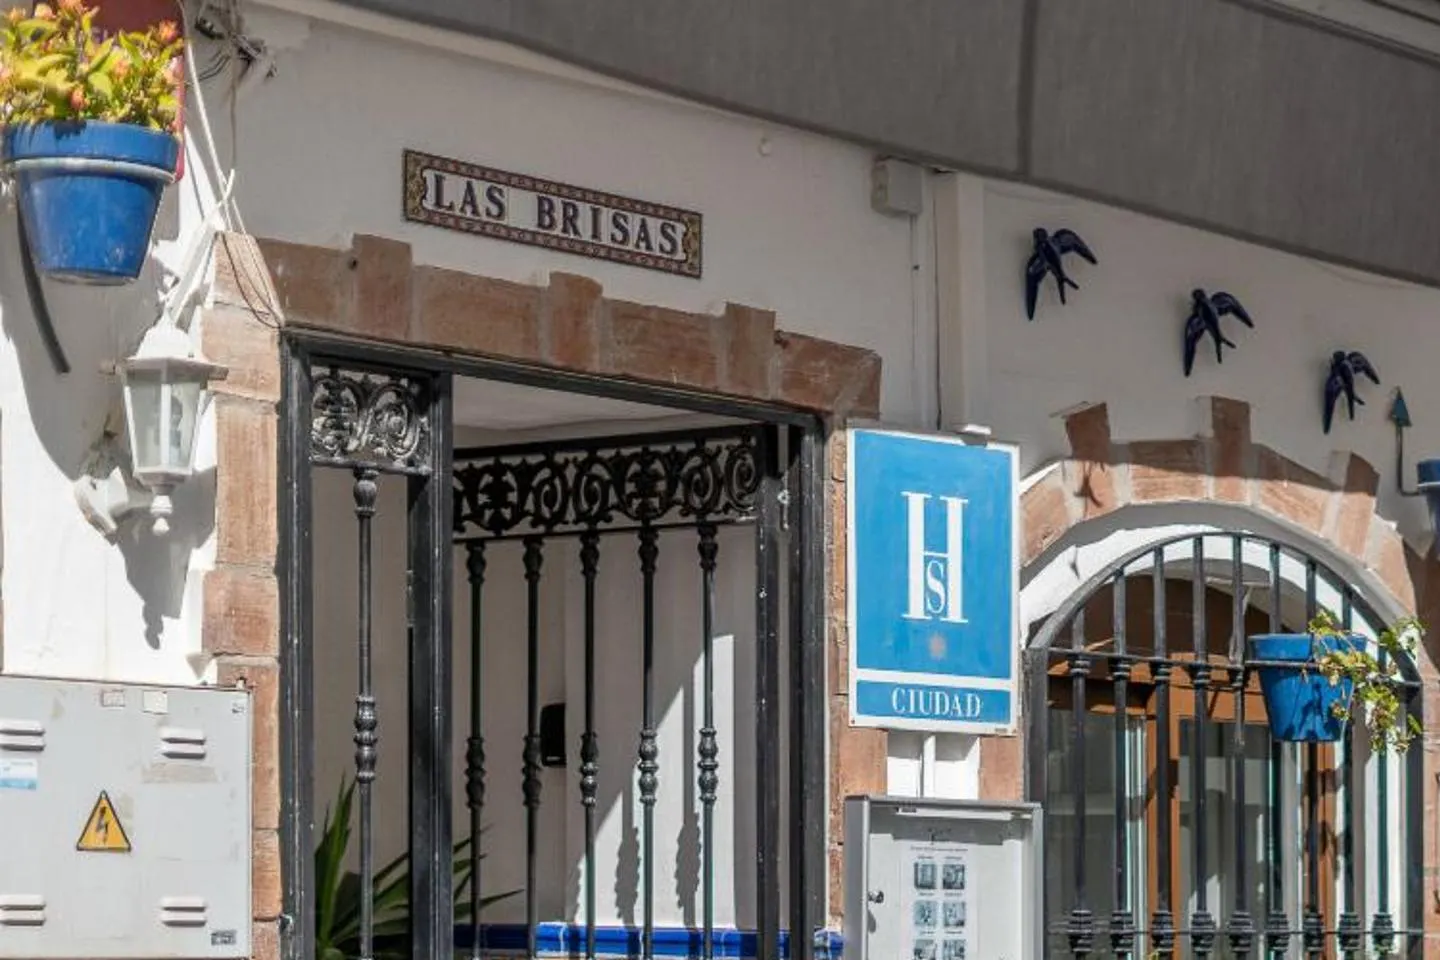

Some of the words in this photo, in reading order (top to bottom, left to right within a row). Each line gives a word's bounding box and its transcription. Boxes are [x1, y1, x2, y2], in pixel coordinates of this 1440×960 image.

[432, 174, 506, 220] LAS
[536, 195, 677, 255] BRISAS
[891, 687, 982, 718] CIUDAD
